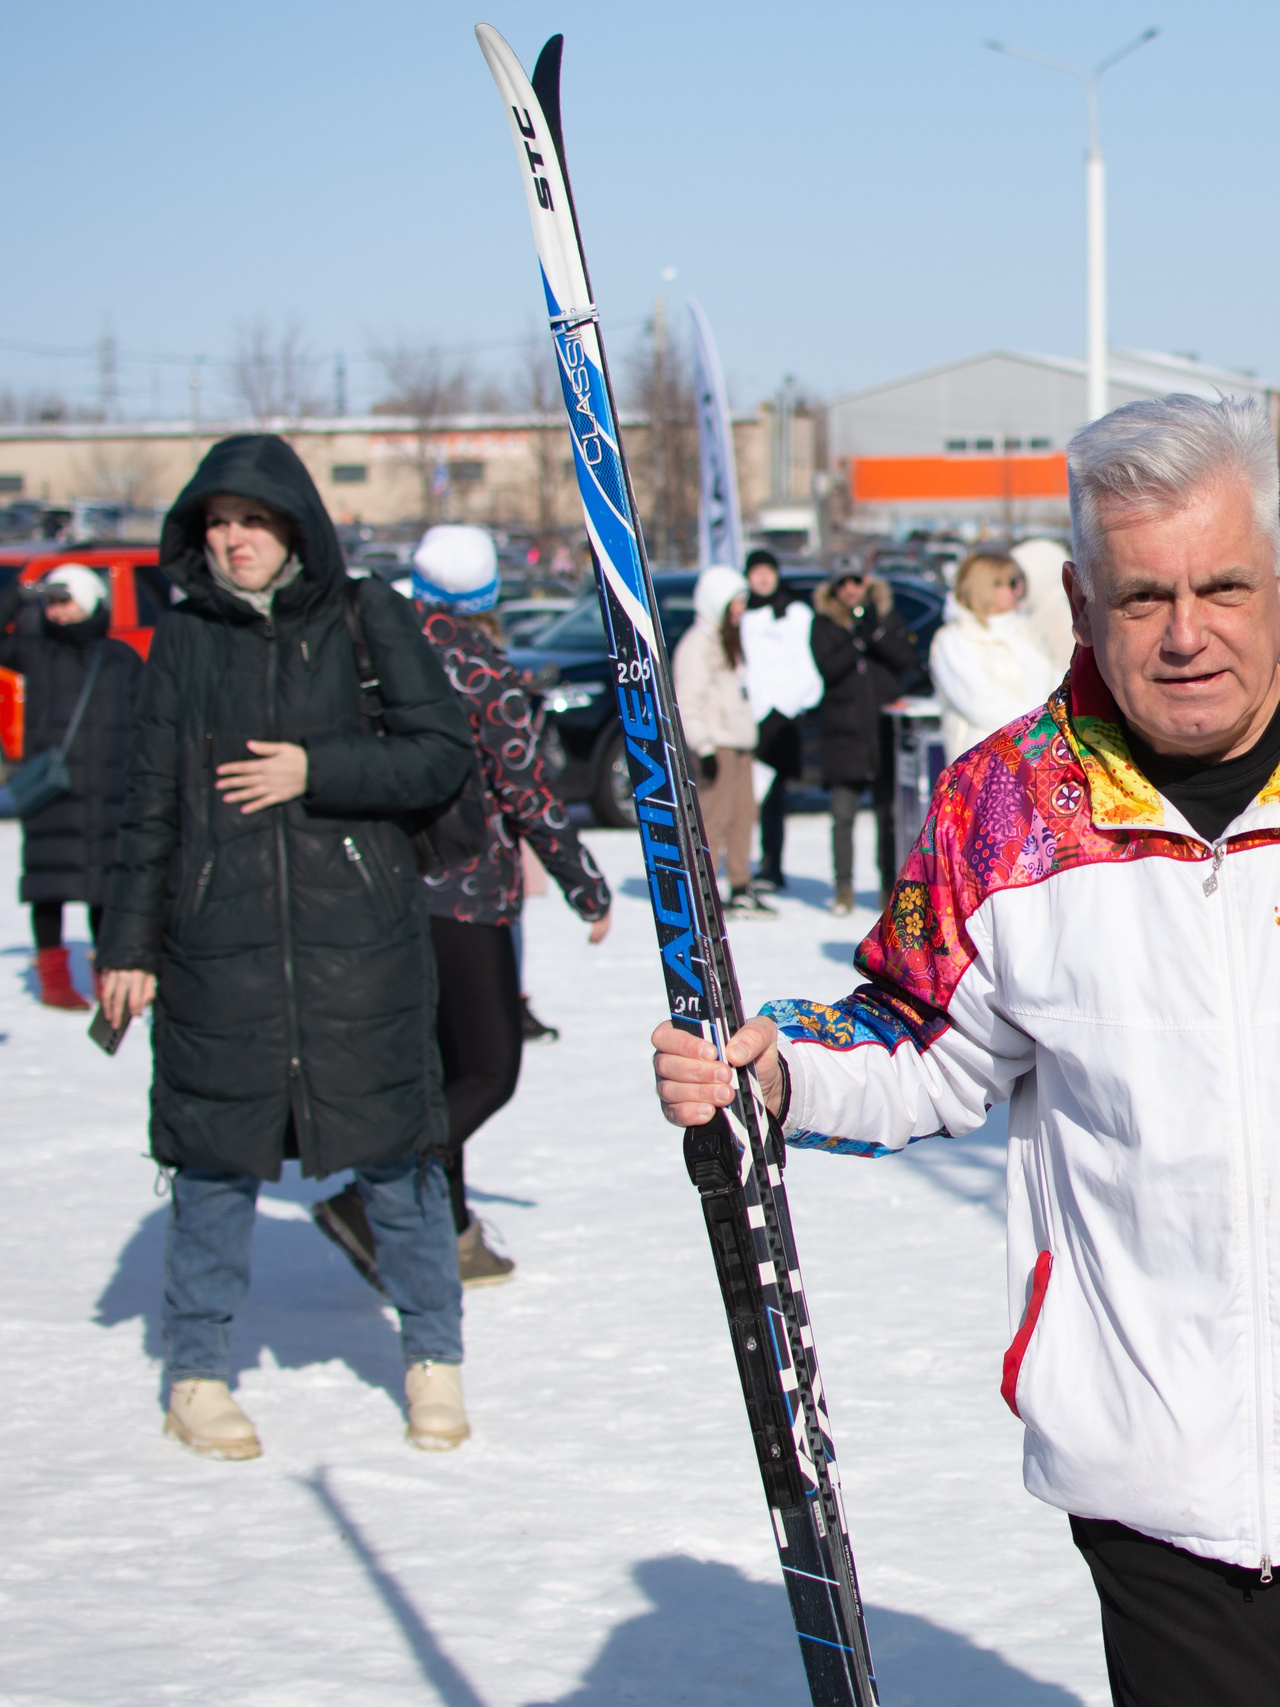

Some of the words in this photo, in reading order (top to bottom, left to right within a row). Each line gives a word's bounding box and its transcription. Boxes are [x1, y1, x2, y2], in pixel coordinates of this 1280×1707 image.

[511, 105, 555, 212] STC
[560, 308, 602, 467] CLASSIC
[617, 657, 651, 684] 205
[616, 686, 704, 997] ACTIVE
